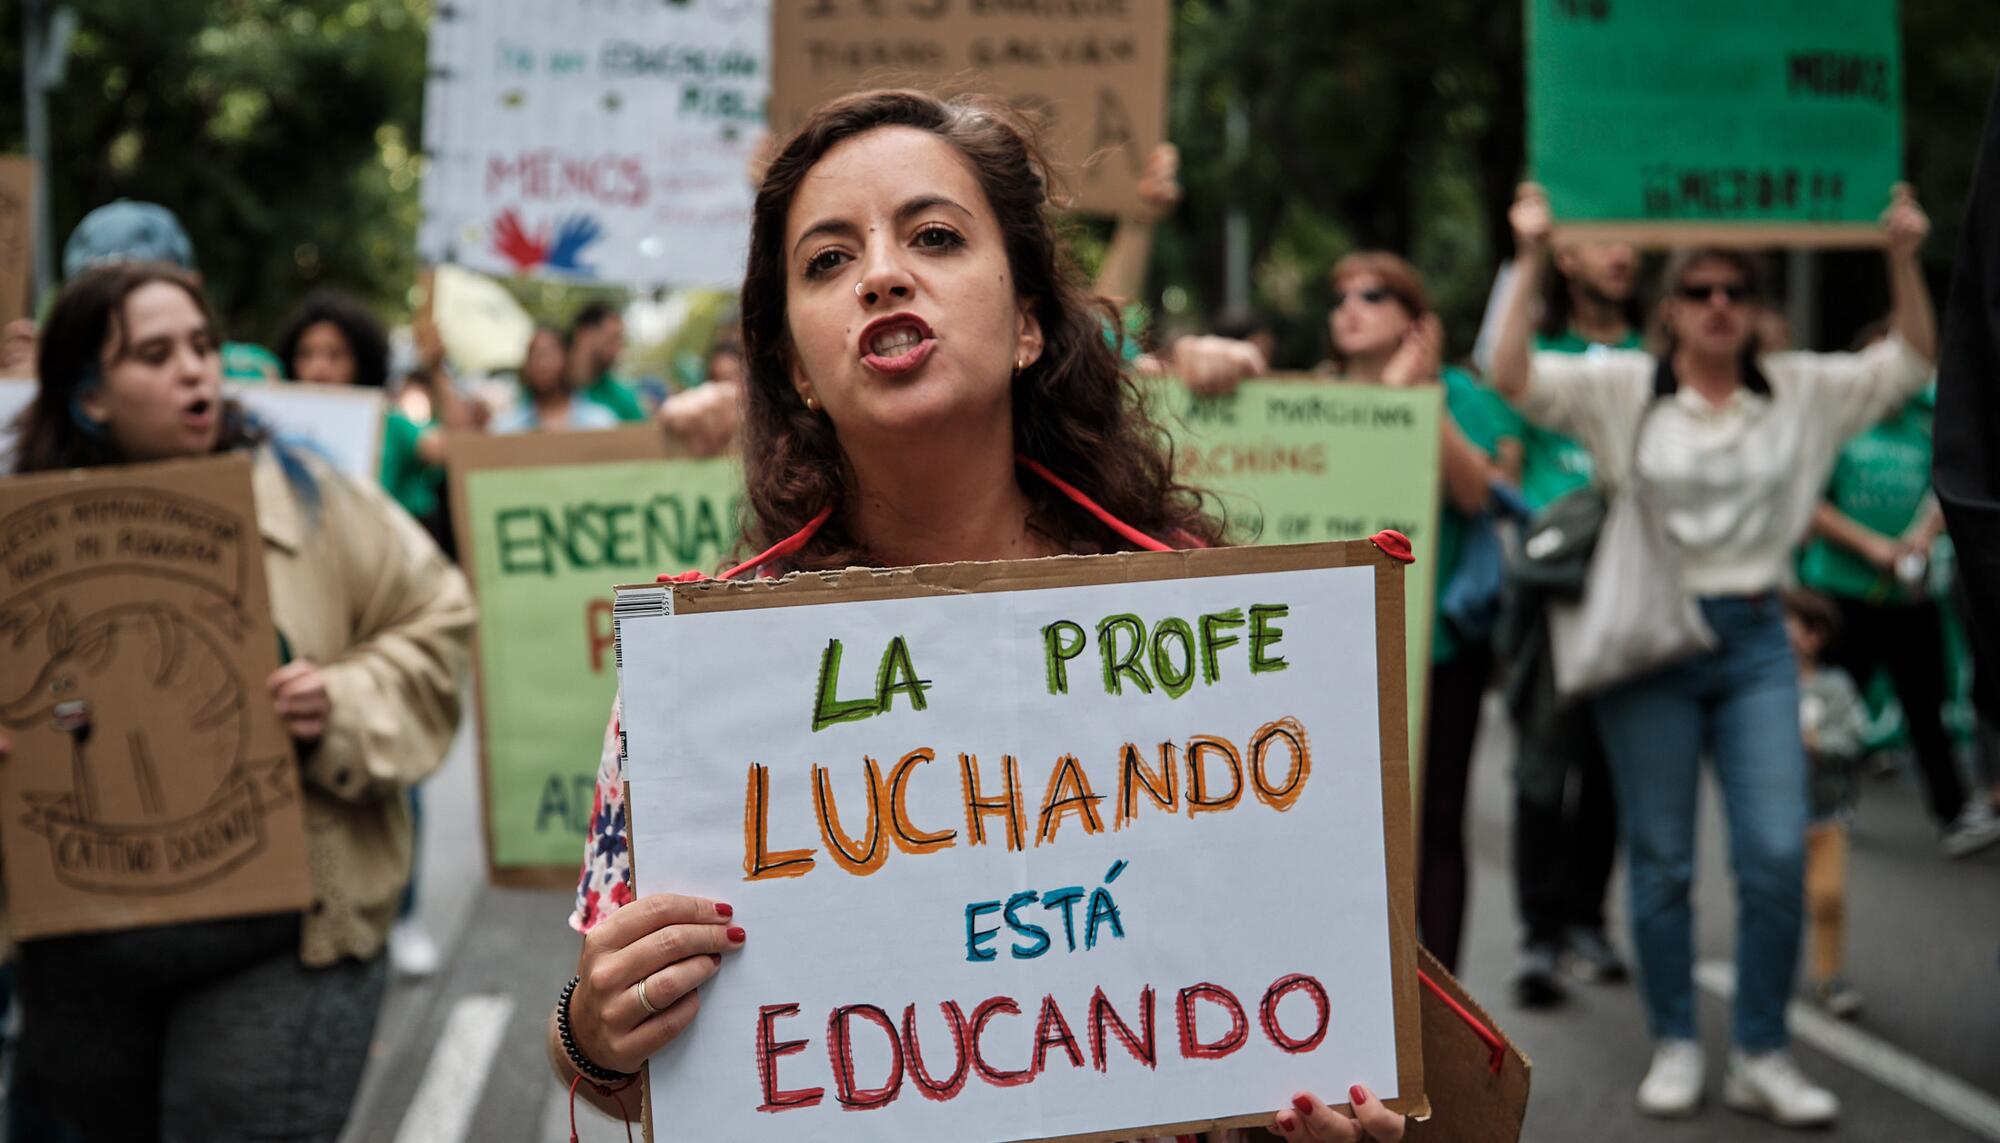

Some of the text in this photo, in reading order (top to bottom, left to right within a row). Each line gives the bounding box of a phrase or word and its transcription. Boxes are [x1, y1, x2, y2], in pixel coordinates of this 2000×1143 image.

[811, 604, 1290, 732] LA PROFE
[743, 715, 1312, 881] LUCHANDO
[965, 860, 1128, 962] ESTÁ
[755, 972, 1331, 1113] EDUCANDO
